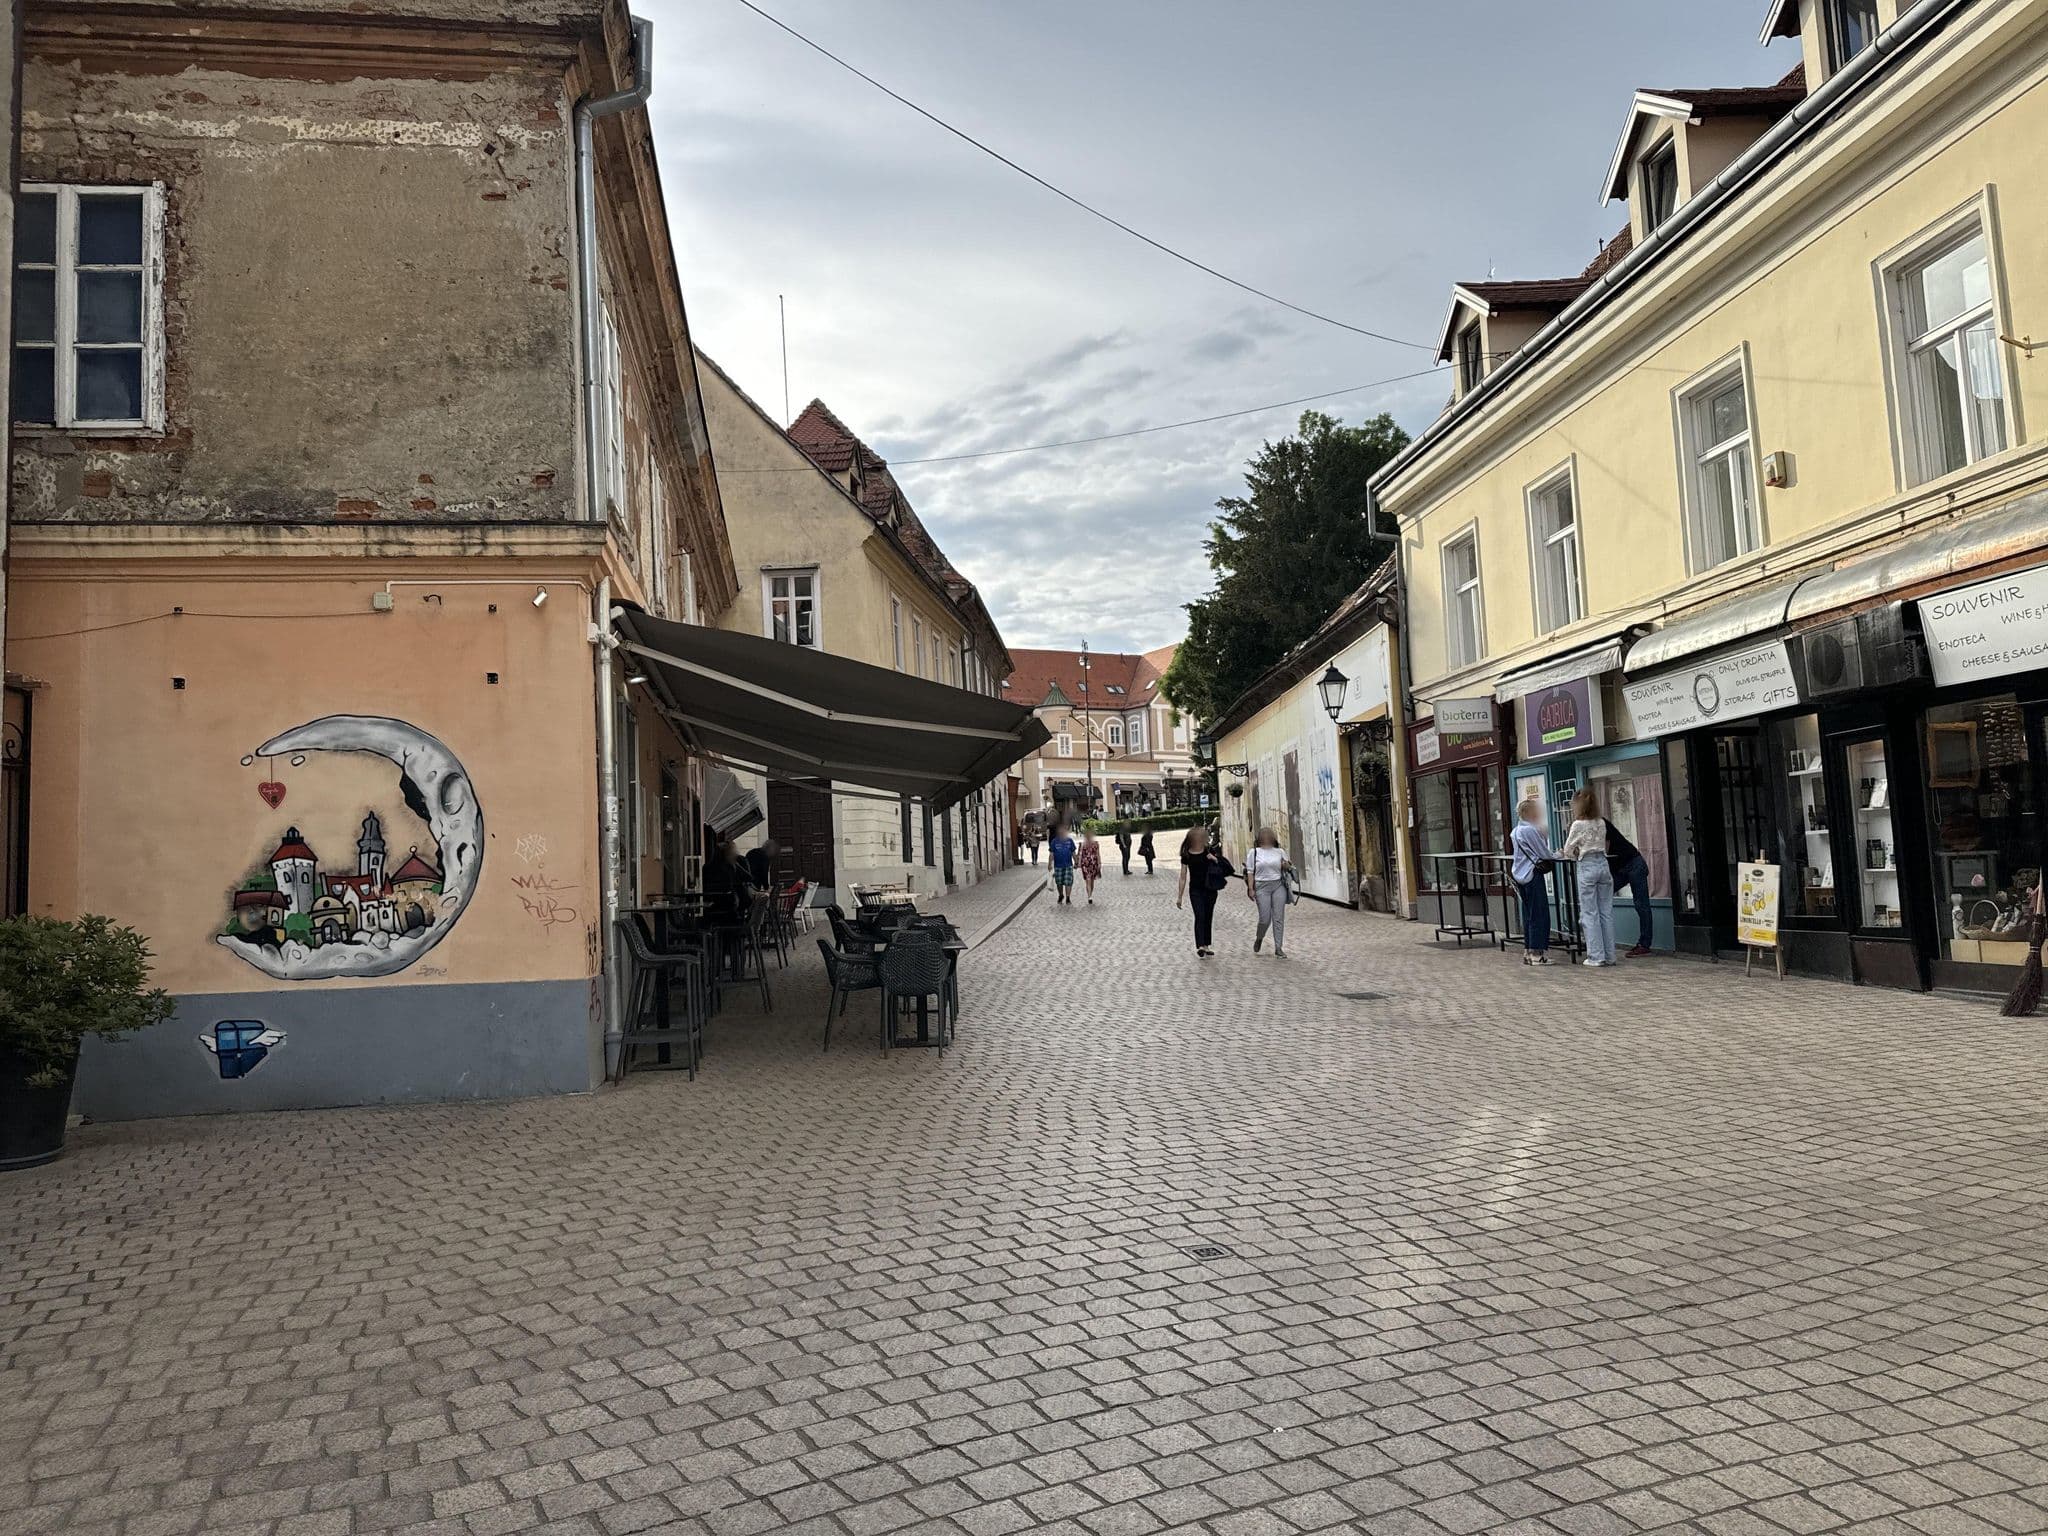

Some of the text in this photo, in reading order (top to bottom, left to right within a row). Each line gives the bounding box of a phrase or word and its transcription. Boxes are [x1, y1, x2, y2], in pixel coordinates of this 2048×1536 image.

[1932, 586, 2025, 620] SOUVENIR
[2000, 608, 2033, 625] WINE
[1938, 633, 1987, 651] ENOTECA
[1718, 651, 1776, 674] ONLY CROATIA
[1962, 653, 2001, 668] CHEESE
[1631, 682, 1673, 701] SOUVENIR
[1724, 692, 1756, 706] STORAGE
[1763, 686, 1795, 704] GIFTS
[1442, 709, 1489, 721] bioterra
